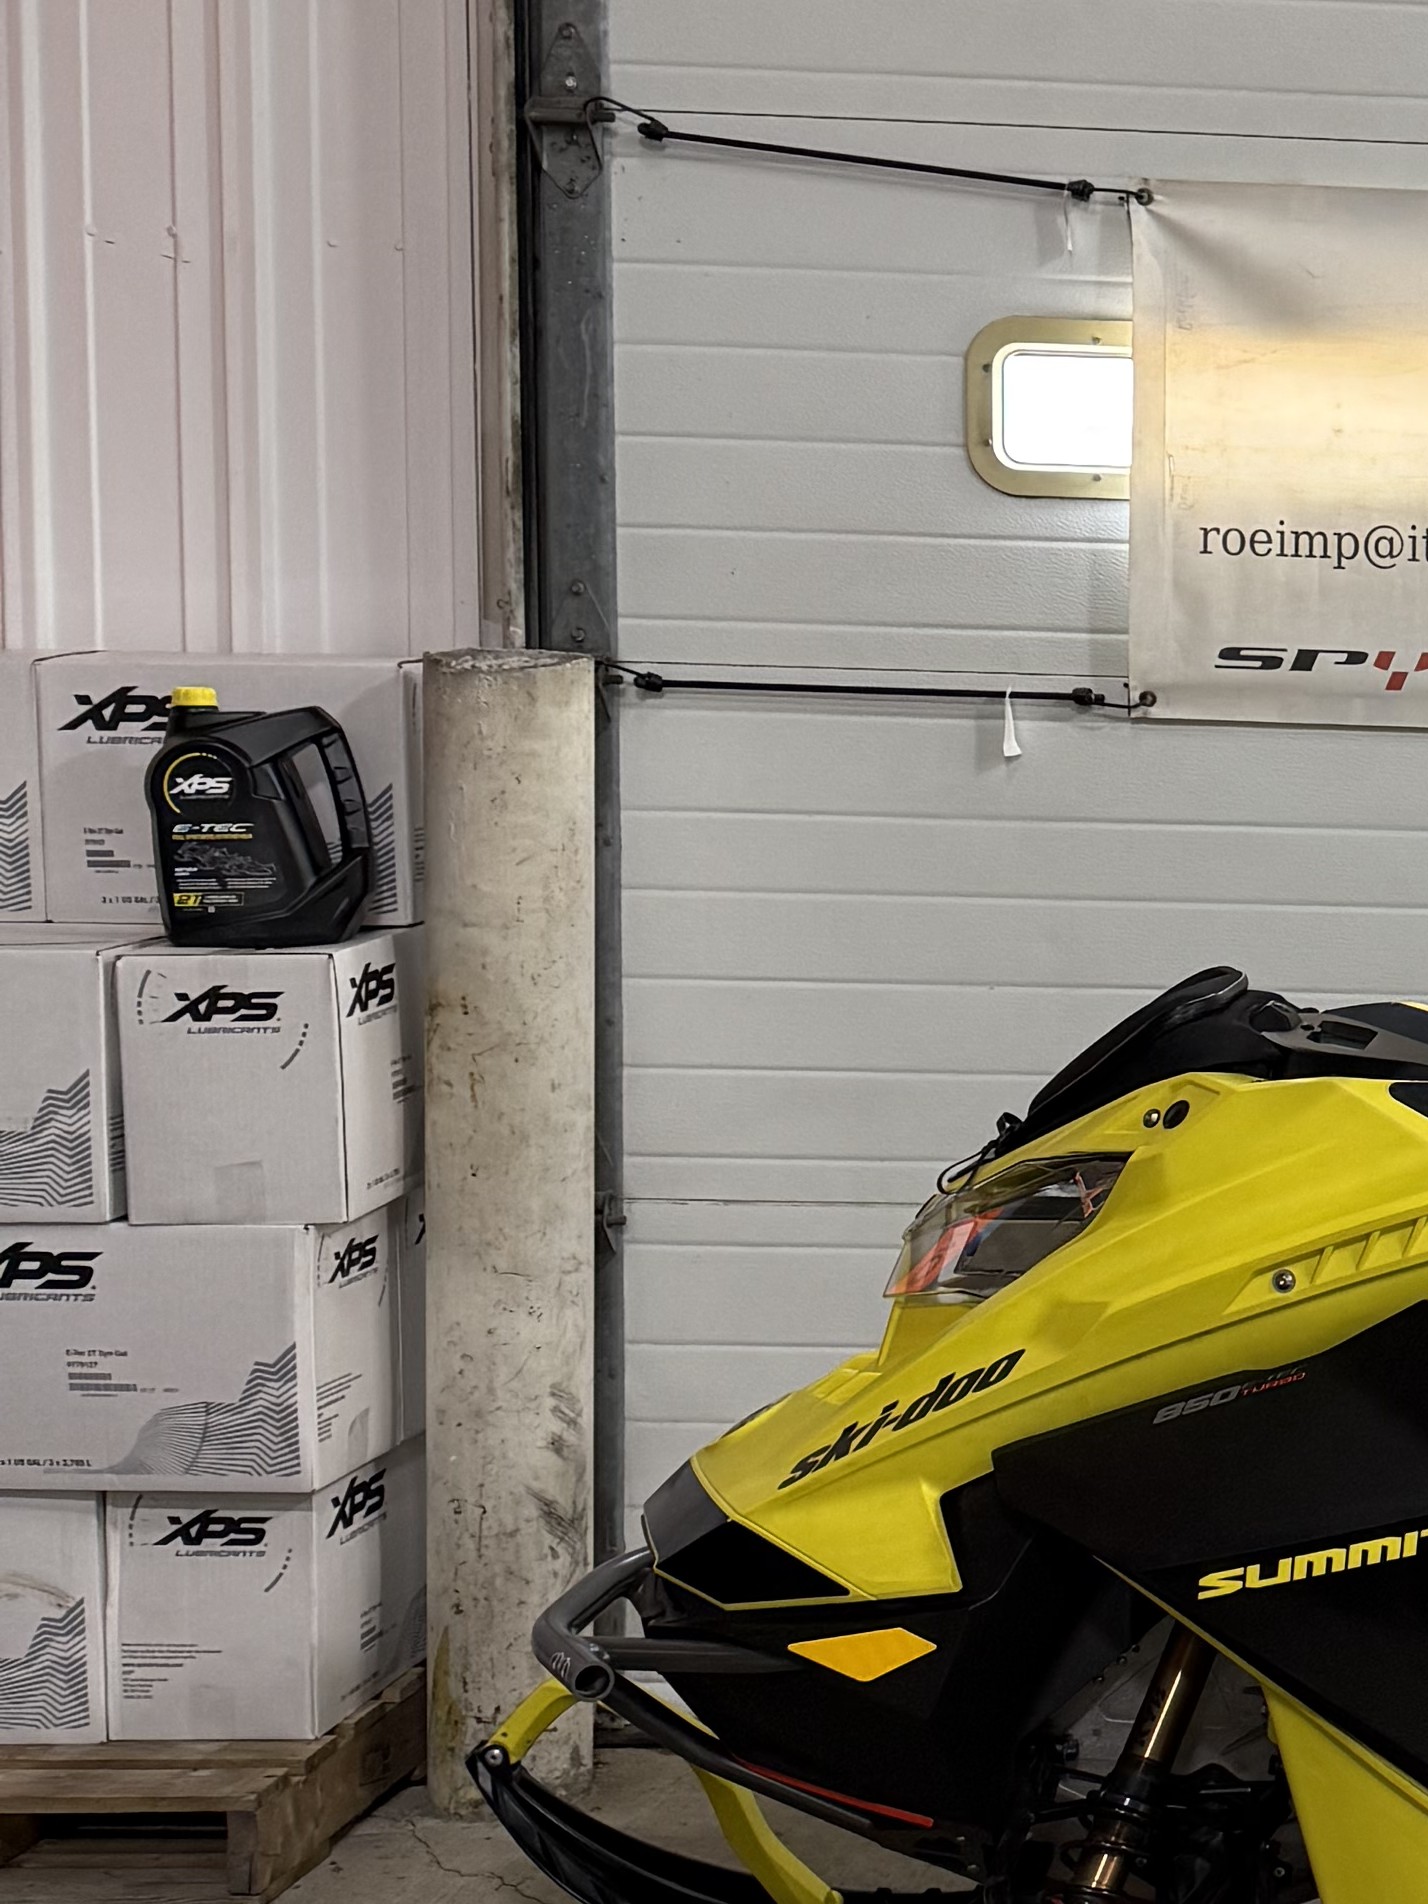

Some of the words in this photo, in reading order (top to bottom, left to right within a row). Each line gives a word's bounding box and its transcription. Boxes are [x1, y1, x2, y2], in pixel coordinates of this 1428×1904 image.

[169, 773, 233, 794] XPS
[161, 984, 285, 1023] XPS
[345, 961, 396, 1018] XPS
[187, 1026, 281, 1034] LUBRICANTS
[327, 1234, 379, 1284] XPS
[778, 1348, 1026, 1490] ski-doo
[1152, 1385, 1242, 1424] 850
[325, 1467, 387, 1539] XPS
[152, 1509, 273, 1547] XPS
[175, 1550, 267, 1558] LUBRICANTS
